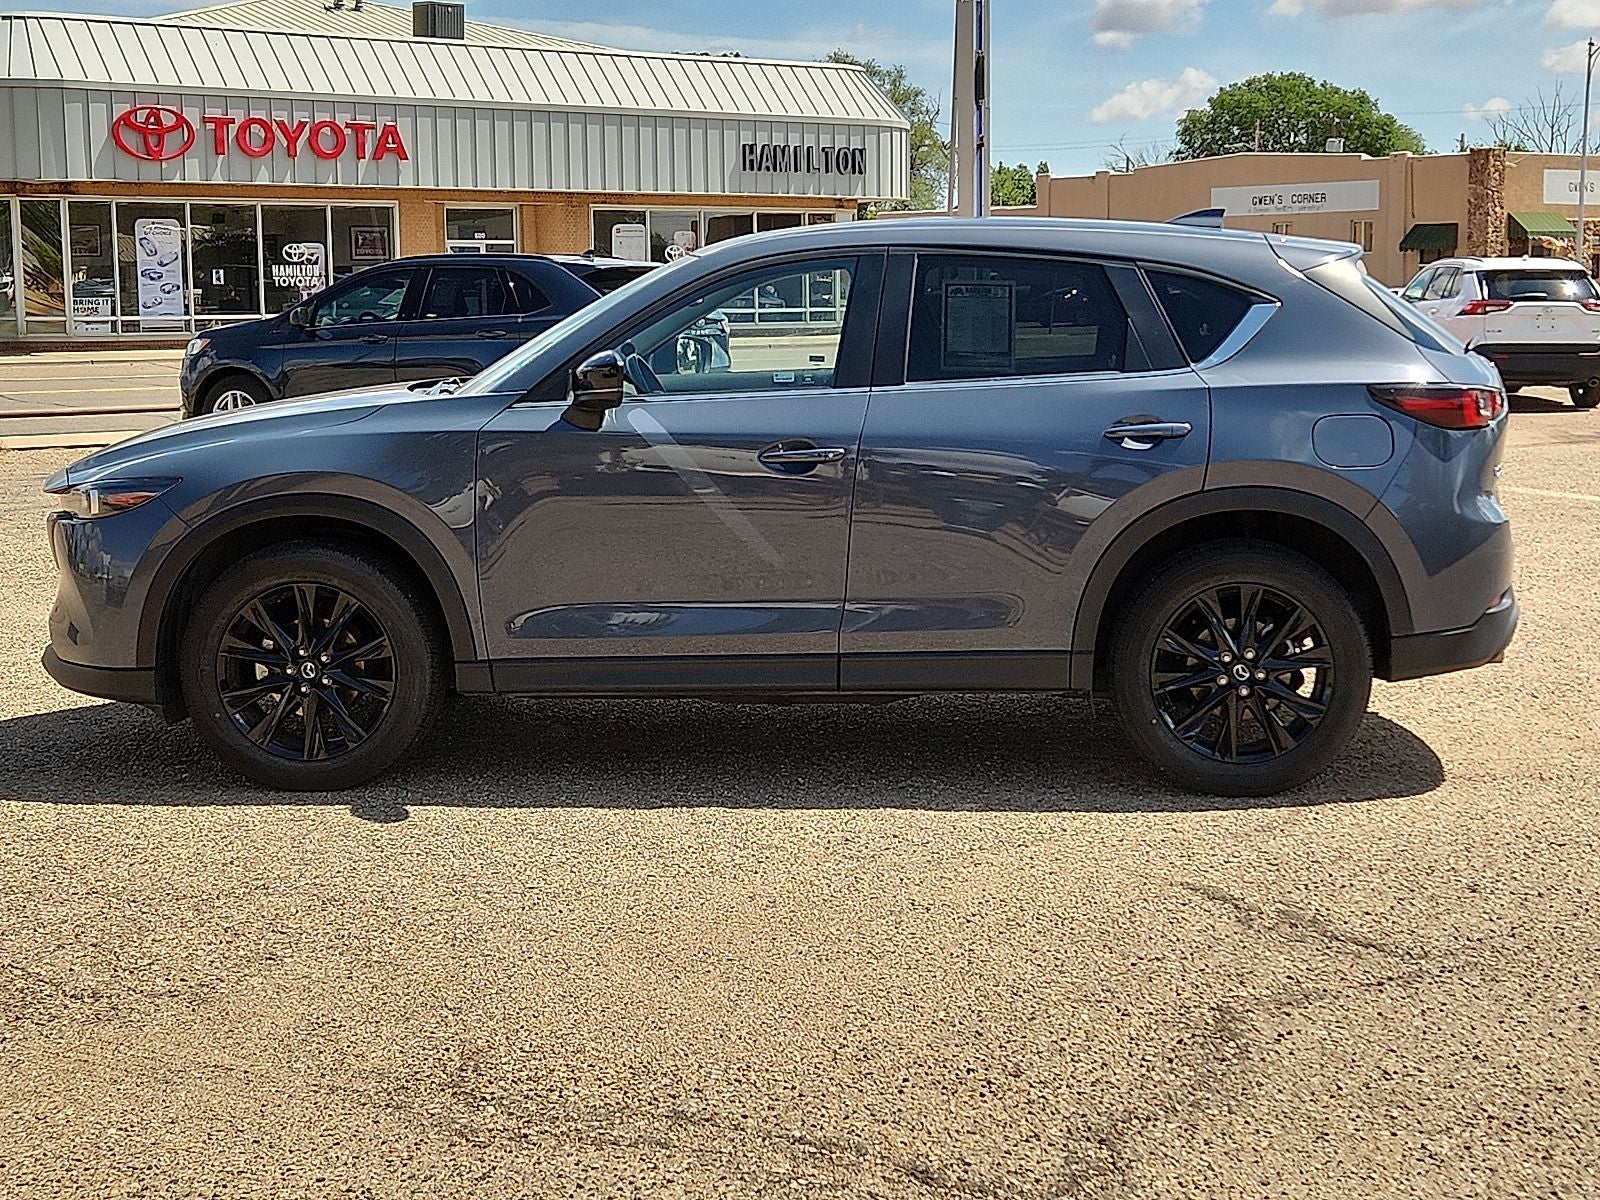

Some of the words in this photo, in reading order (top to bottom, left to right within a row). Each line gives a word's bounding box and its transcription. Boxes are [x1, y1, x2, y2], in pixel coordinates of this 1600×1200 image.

[202, 114, 409, 161] TOYOTA
[741, 143, 867, 176] HAMILTON
[1251, 193, 1283, 206] GWEN'S
[1291, 192, 1327, 204] CORNER
[271, 264, 320, 277] HAMILTON
[272, 276, 320, 288] TOYOTA
[72, 306, 100, 314] HOME
